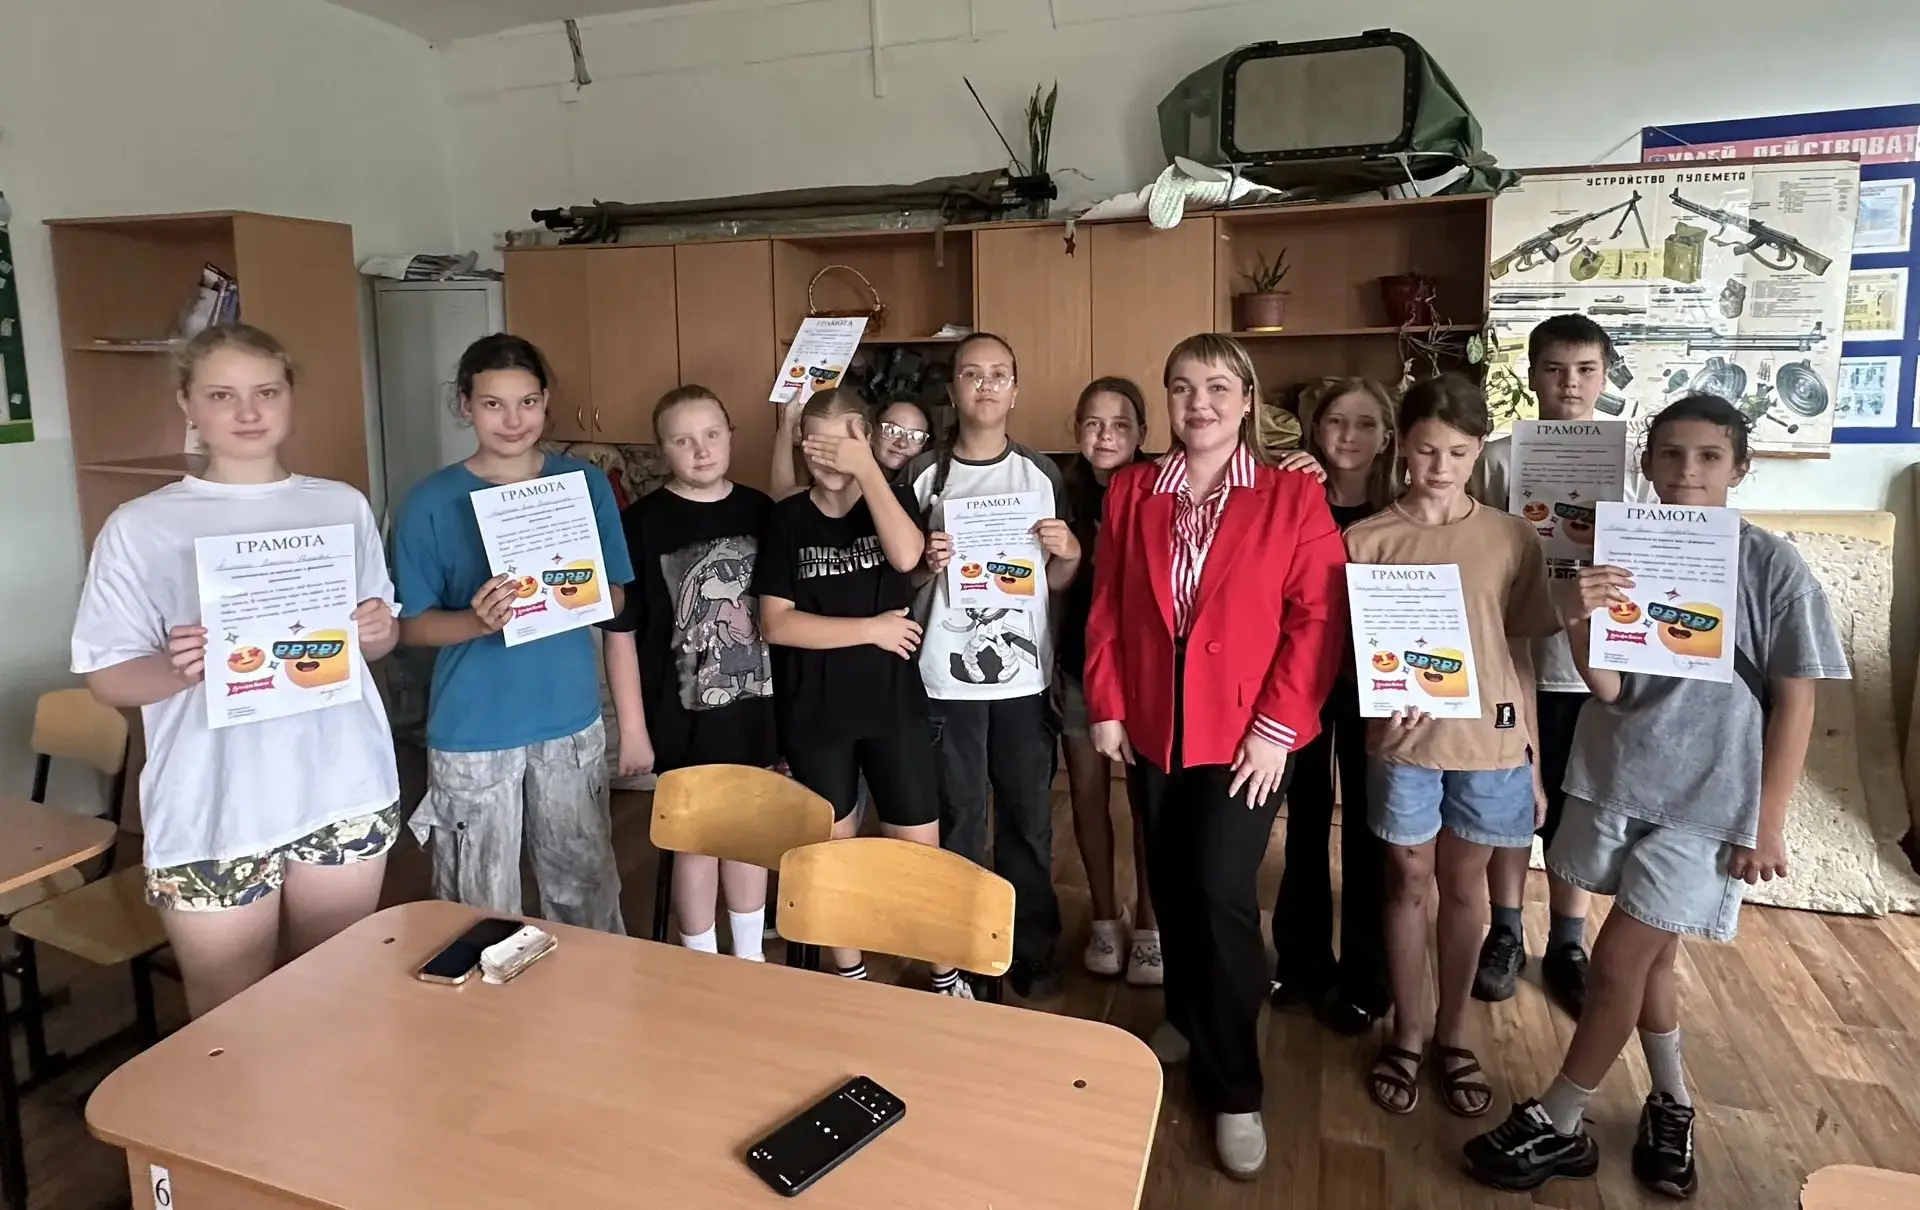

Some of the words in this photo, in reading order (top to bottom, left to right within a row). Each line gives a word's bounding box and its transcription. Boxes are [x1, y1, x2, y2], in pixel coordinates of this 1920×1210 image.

[1586, 174, 1665, 186] УСТРОЙСТВО
[1676, 172, 1746, 183] ПУЛЕМЕТА
[1536, 424, 1601, 436] ГРАМОТА
[500, 481, 566, 502] ГРАМОТА
[966, 497, 1021, 510] ГРАМОТА
[1626, 508, 1708, 523] ГРАМОТА
[236, 534, 325, 554] ГРАМОТА
[1371, 570, 1437, 580] ГРАМОТА
[155, 1178, 170, 1206] 6
